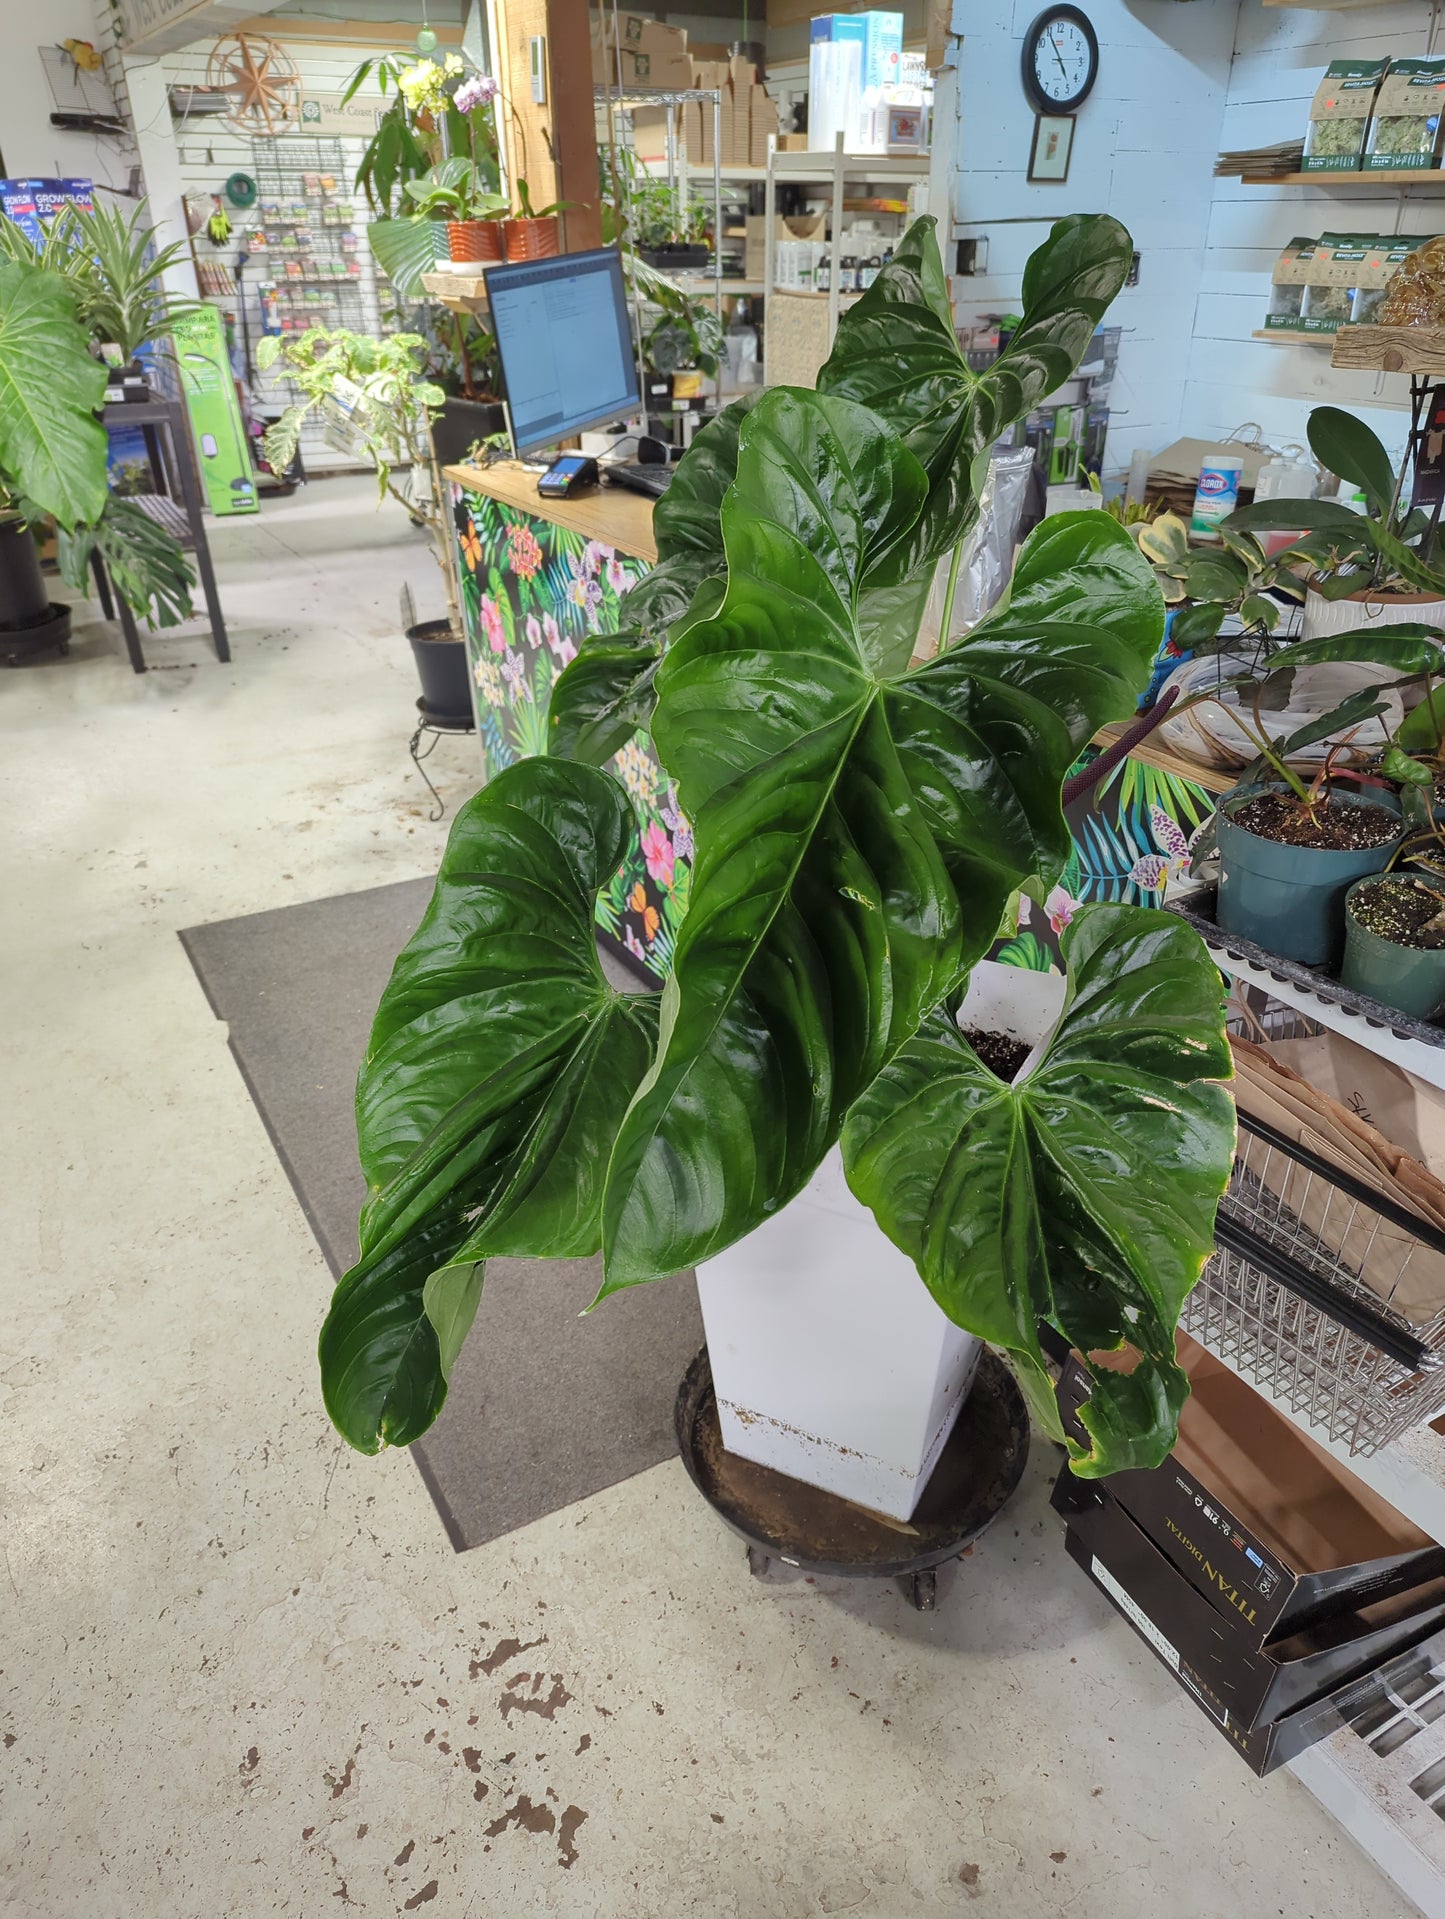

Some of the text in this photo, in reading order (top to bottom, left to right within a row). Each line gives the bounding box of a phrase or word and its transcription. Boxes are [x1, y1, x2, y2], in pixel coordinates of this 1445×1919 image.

[1057, 23, 1064, 33] 12
[1069, 28, 1073, 39] 1
[1038, 38, 1046, 49] 10
[1075, 40, 1080, 51] 2
[1078, 56, 1083, 67] 3
[1073, 73, 1078, 83] 4
[1045, 82, 1049, 93] 7
[1053, 87, 1059, 97] 6
[1065, 84, 1070, 94] 5
[1200, 478, 1225, 489] CLOROX
[1164, 1516, 1256, 1627] TITAN DIGITAL
[1183, 1660, 1222, 1708] TITAN
